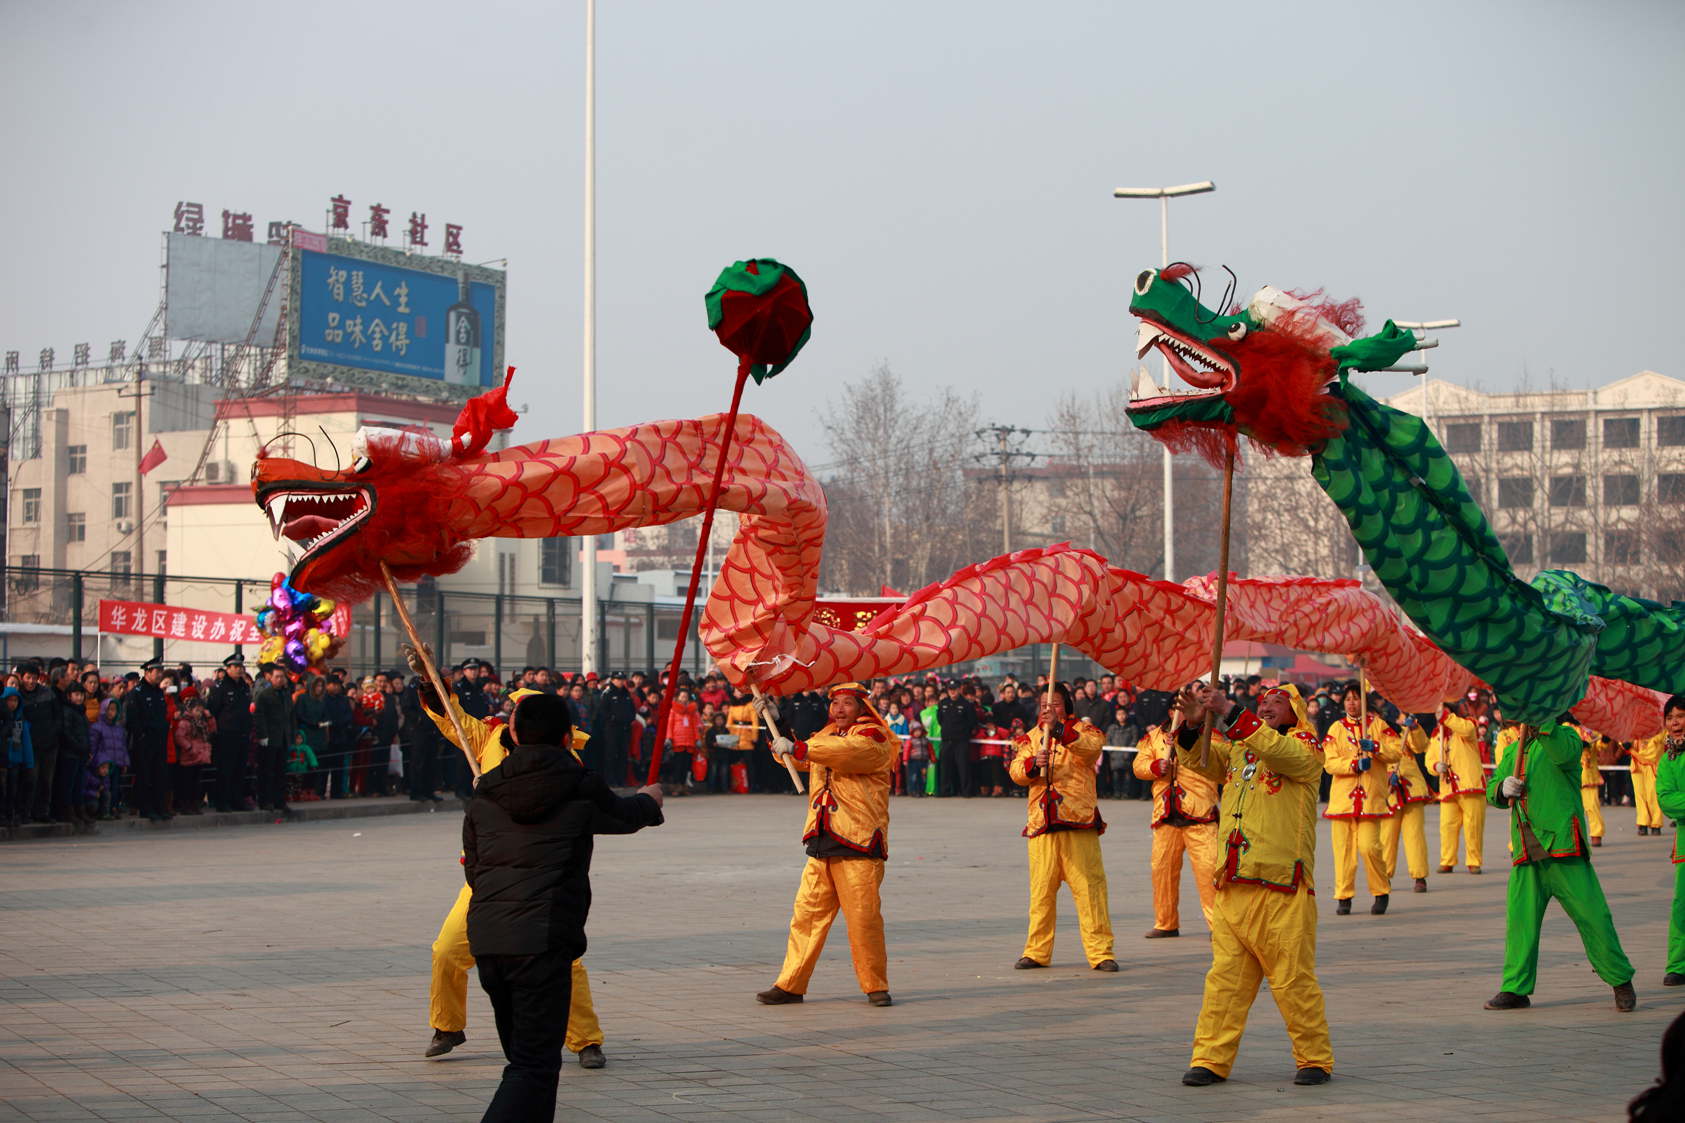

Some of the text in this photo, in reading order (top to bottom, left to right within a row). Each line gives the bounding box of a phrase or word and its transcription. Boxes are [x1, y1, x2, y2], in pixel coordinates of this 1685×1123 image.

[327, 266, 411, 313] 智慧人生
[325, 312, 411, 356] 品味舍得
